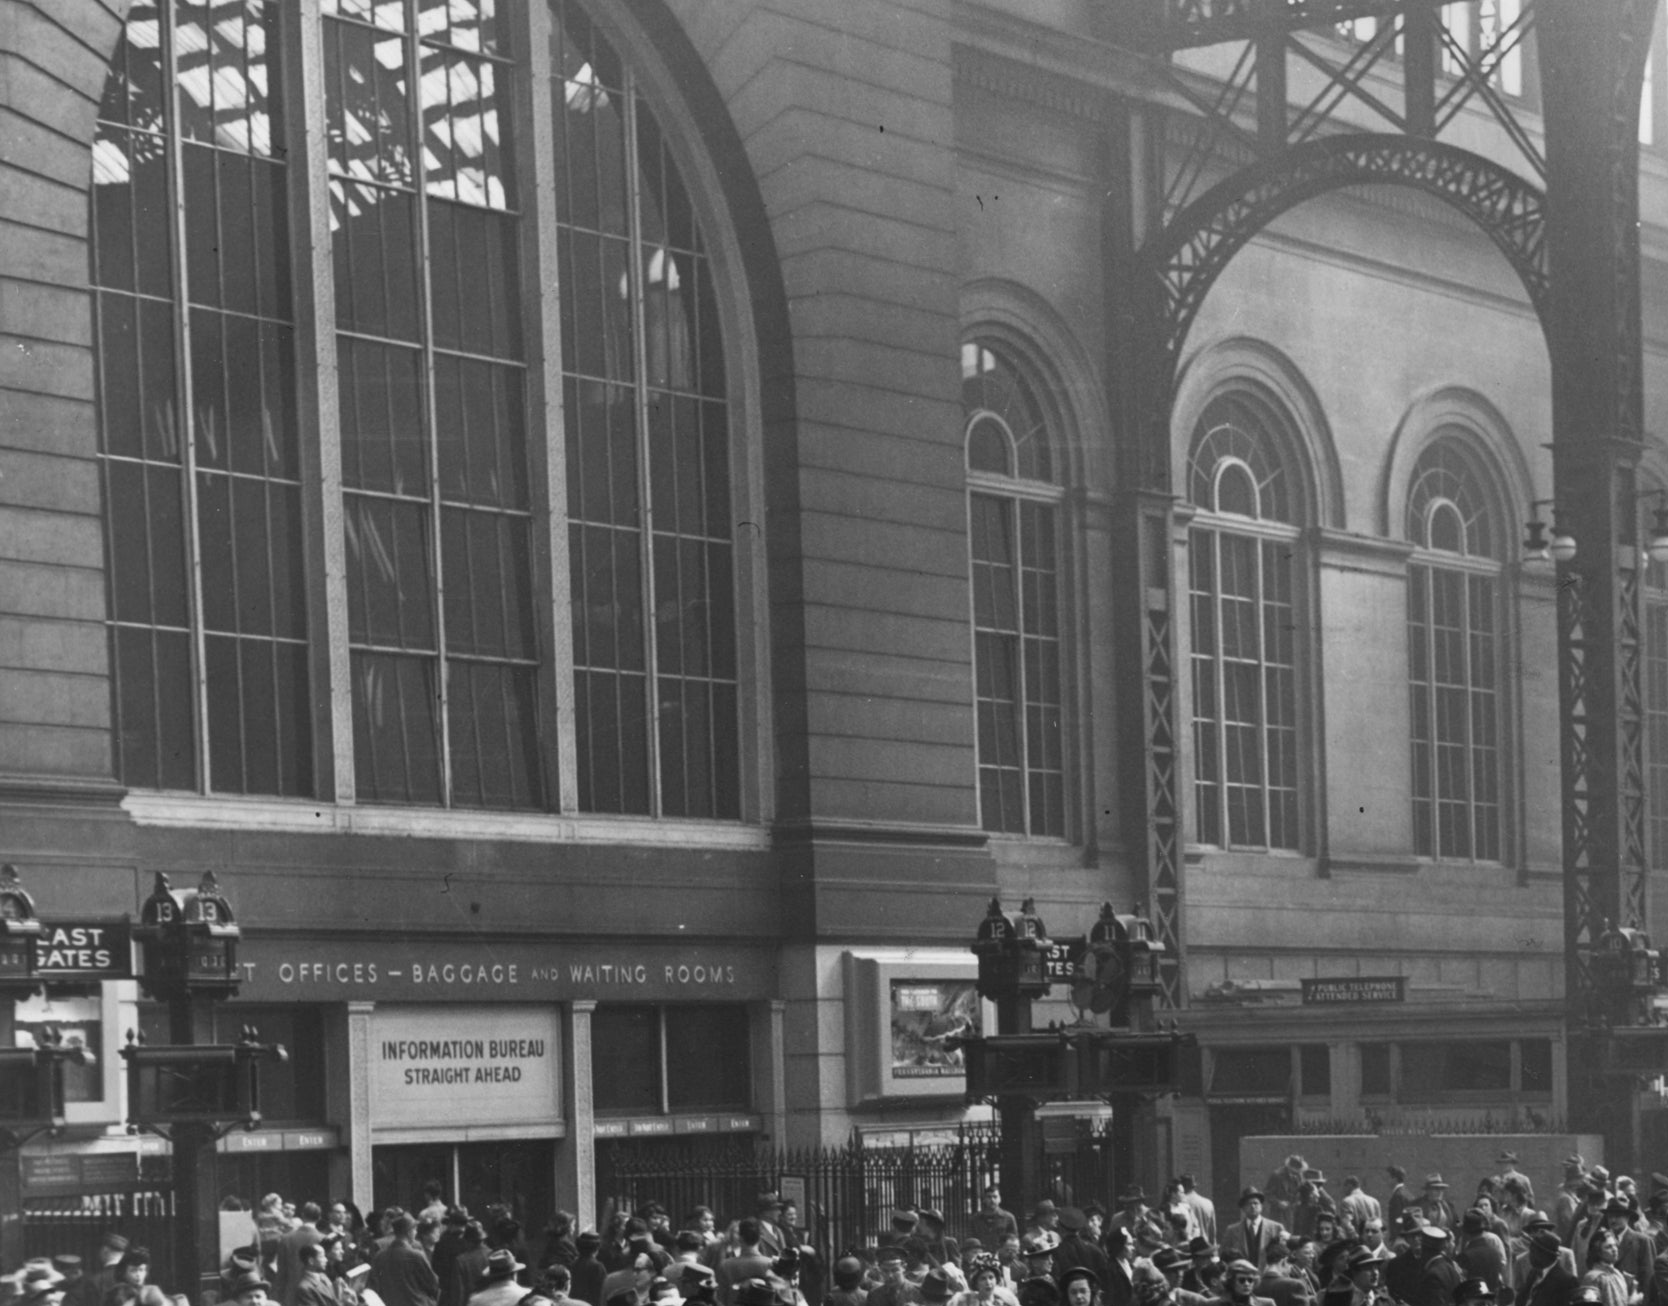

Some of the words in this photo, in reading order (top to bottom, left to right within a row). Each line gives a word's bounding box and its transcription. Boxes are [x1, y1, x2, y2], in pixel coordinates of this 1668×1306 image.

[156, 902, 172, 922] 13
[198, 902, 217, 921] 13
[991, 923, 1005, 938] 12
[1024, 922, 1036, 938] 12
[1104, 925, 1116, 940] 11
[1136, 925, 1146, 940] 11
[278, 963, 378, 983] OFFICES
[412, 964, 517, 983] BAGGAGE
[531, 968, 559, 981] AND
[569, 964, 647, 983] WAITING
[664, 964, 735, 984] ROOMS
[1317, 983, 1346, 992] PUBLIC
[1349, 982, 1397, 991] TELEPHONE
[1315, 991, 1359, 1001] ATTENDED
[1362, 991, 1397, 1000] SERVICE
[382, 1041, 484, 1060] INFORMATION
[489, 1040, 545, 1058] BUREAU
[404, 1068, 470, 1084] STRAIGHT
[475, 1066, 522, 1083] AHEAD
